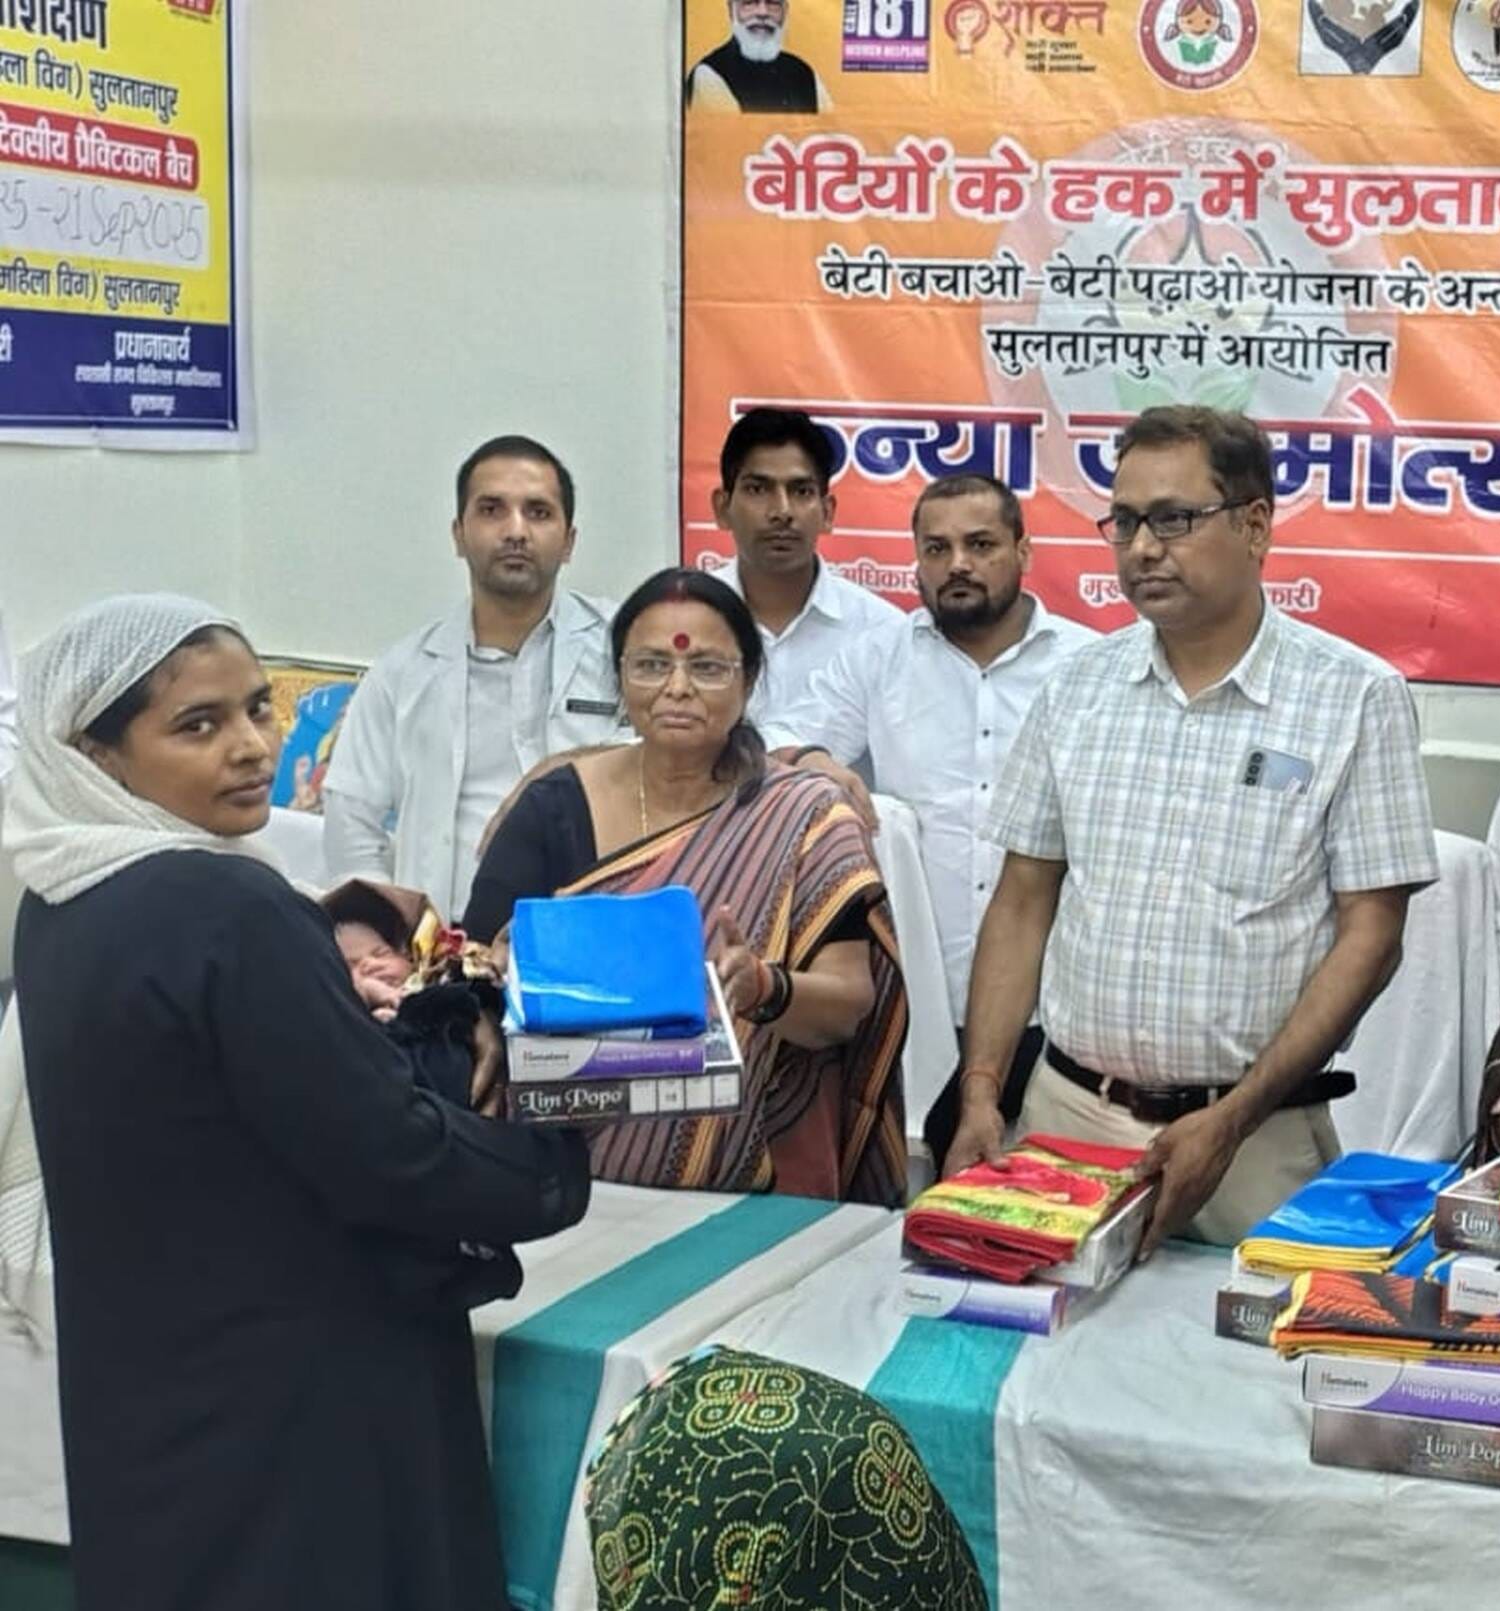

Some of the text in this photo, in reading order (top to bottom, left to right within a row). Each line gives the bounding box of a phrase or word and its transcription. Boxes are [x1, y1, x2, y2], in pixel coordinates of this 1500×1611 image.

[857, 0, 926, 38] 181
[88, 70, 178, 124] सुलतानपुर
[165, 138, 194, 184] बैच
[751, 140, 942, 216] बेटियों
[954, 145, 1031, 216] के
[1050, 167, 1181, 222] हक
[1201, 150, 1276, 222] में
[104, 275, 181, 315] सुलतानपुर
[821, 247, 892, 295] बेटी
[1128, 257, 1247, 312] पढ़ाओ
[1258, 258, 1377, 306] योजना
[1387, 262, 1428, 308] के
[114, 326, 191, 362] प्रधानाचार्य
[986, 320, 1392, 379] सुलतानपुर में आयोजित
[1400, 1383, 1448, 1403] Happy
[1450, 1389, 1486, 1406] Baby
